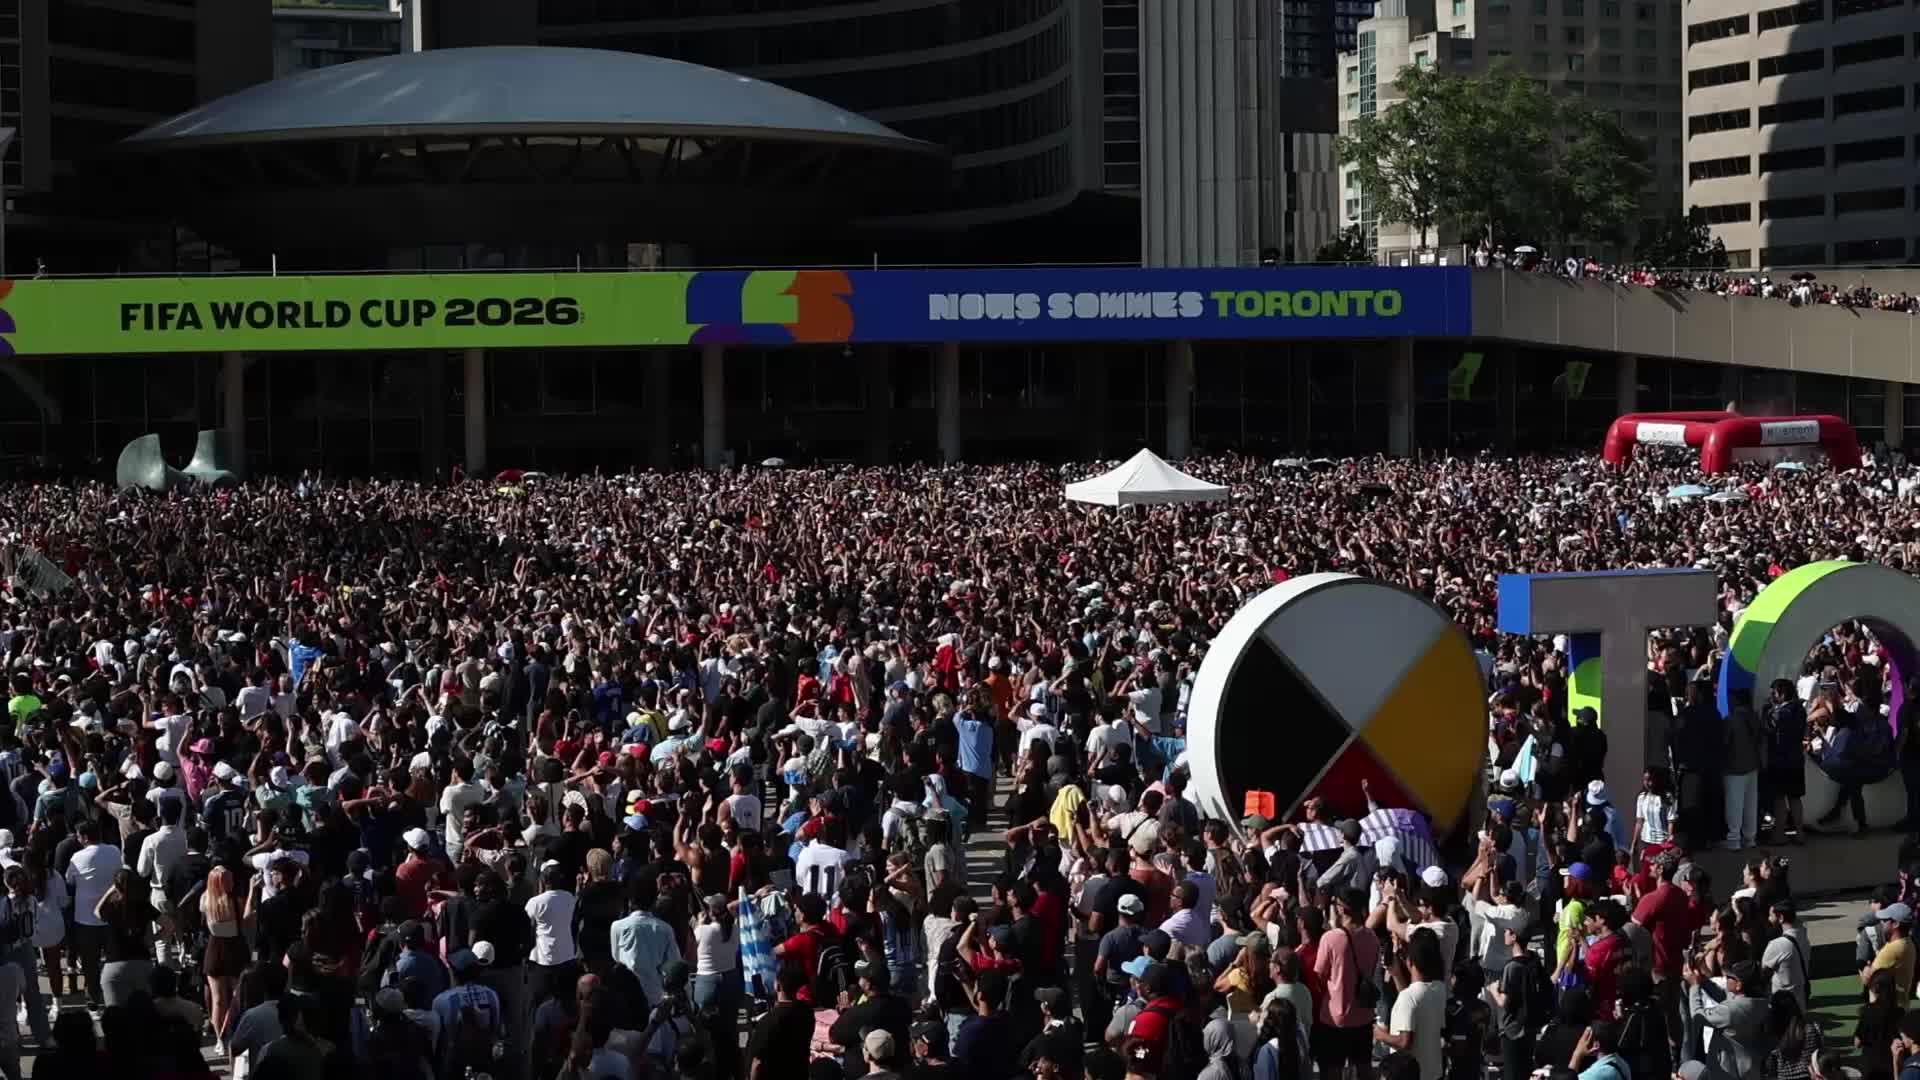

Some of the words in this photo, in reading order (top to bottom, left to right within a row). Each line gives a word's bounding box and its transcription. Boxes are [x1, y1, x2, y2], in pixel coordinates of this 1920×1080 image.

[121, 302, 202, 331] FIFA
[209, 301, 351, 330] WORLD
[359, 299, 437, 328] CUP
[444, 297, 579, 326] 2026
[928, 292, 1041, 320] NOUS
[1047, 291, 1204, 319] SOMMES
[1209, 289, 1402, 318] TORONTO
[810, 864, 835, 896] 11
